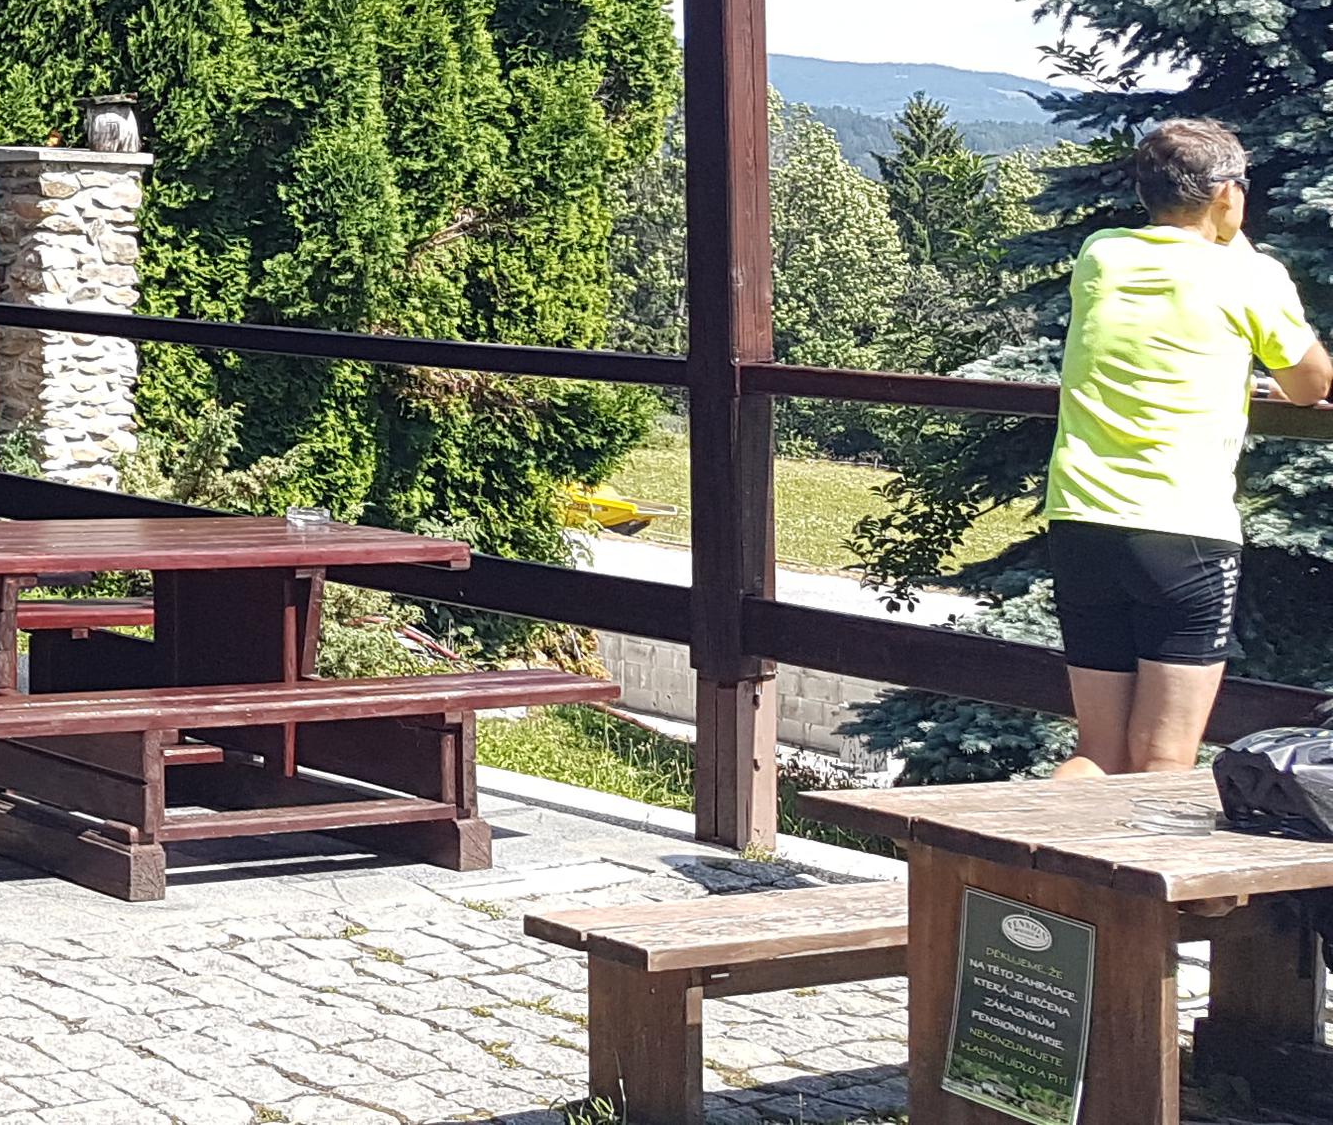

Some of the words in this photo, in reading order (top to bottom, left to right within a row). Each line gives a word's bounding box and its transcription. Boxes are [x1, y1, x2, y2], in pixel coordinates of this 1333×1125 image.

[969, 958, 986, 971] NA
[1048, 965, 1064, 980] ŽE
[973, 976, 1009, 996] KTERÁ
[1010, 990, 1024, 1001] JE
[1025, 995, 1071, 1018] URČENA
[983, 996, 1057, 1030] ZÁKAZNÍKŮM
[971, 1009, 1027, 1036] PENSIONU
[960, 1040, 1005, 1064] VLASTNÍ
[1005, 1057, 1037, 1074] JÍDLO
[1037, 1070, 1047, 1079] A
[1047, 1073, 1069, 1087] PITÍ
[969, 1026, 1063, 1067] NEKONZUMUJETE
